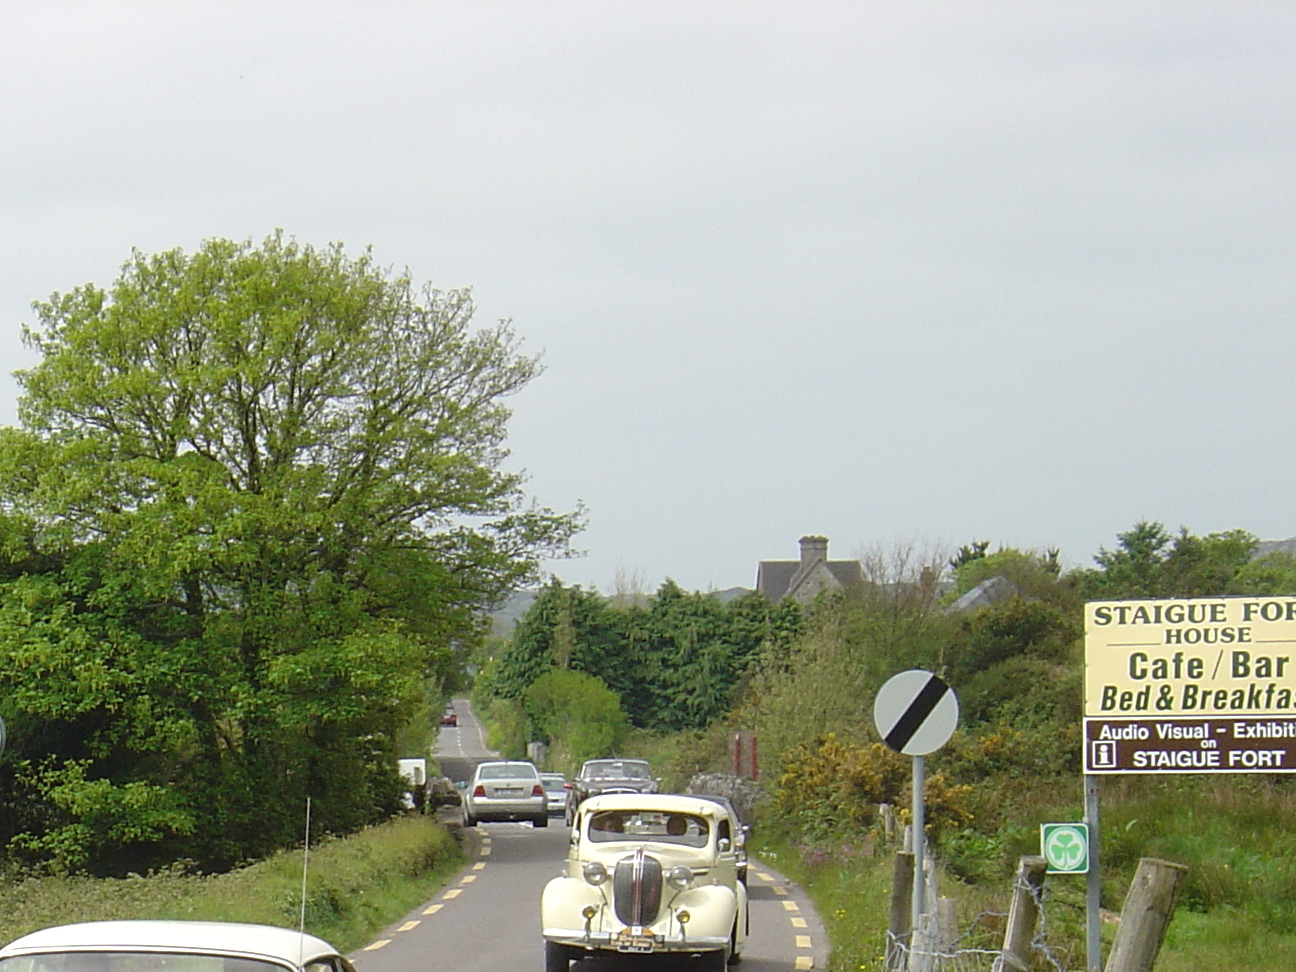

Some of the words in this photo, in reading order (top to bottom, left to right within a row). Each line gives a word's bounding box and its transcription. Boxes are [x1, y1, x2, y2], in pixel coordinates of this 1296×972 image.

[1094, 603, 1227, 626] STAIGUE
[1165, 626, 1252, 644] HOUSE
[1181, 682, 1296, 711] Breakfa
[1099, 723, 1150, 740] Audio
[1155, 722, 1209, 739] Visual
[1199, 738, 1217, 749] on
[1132, 749, 1221, 768] STAIGUE
[1228, 749, 1286, 767] FORT
